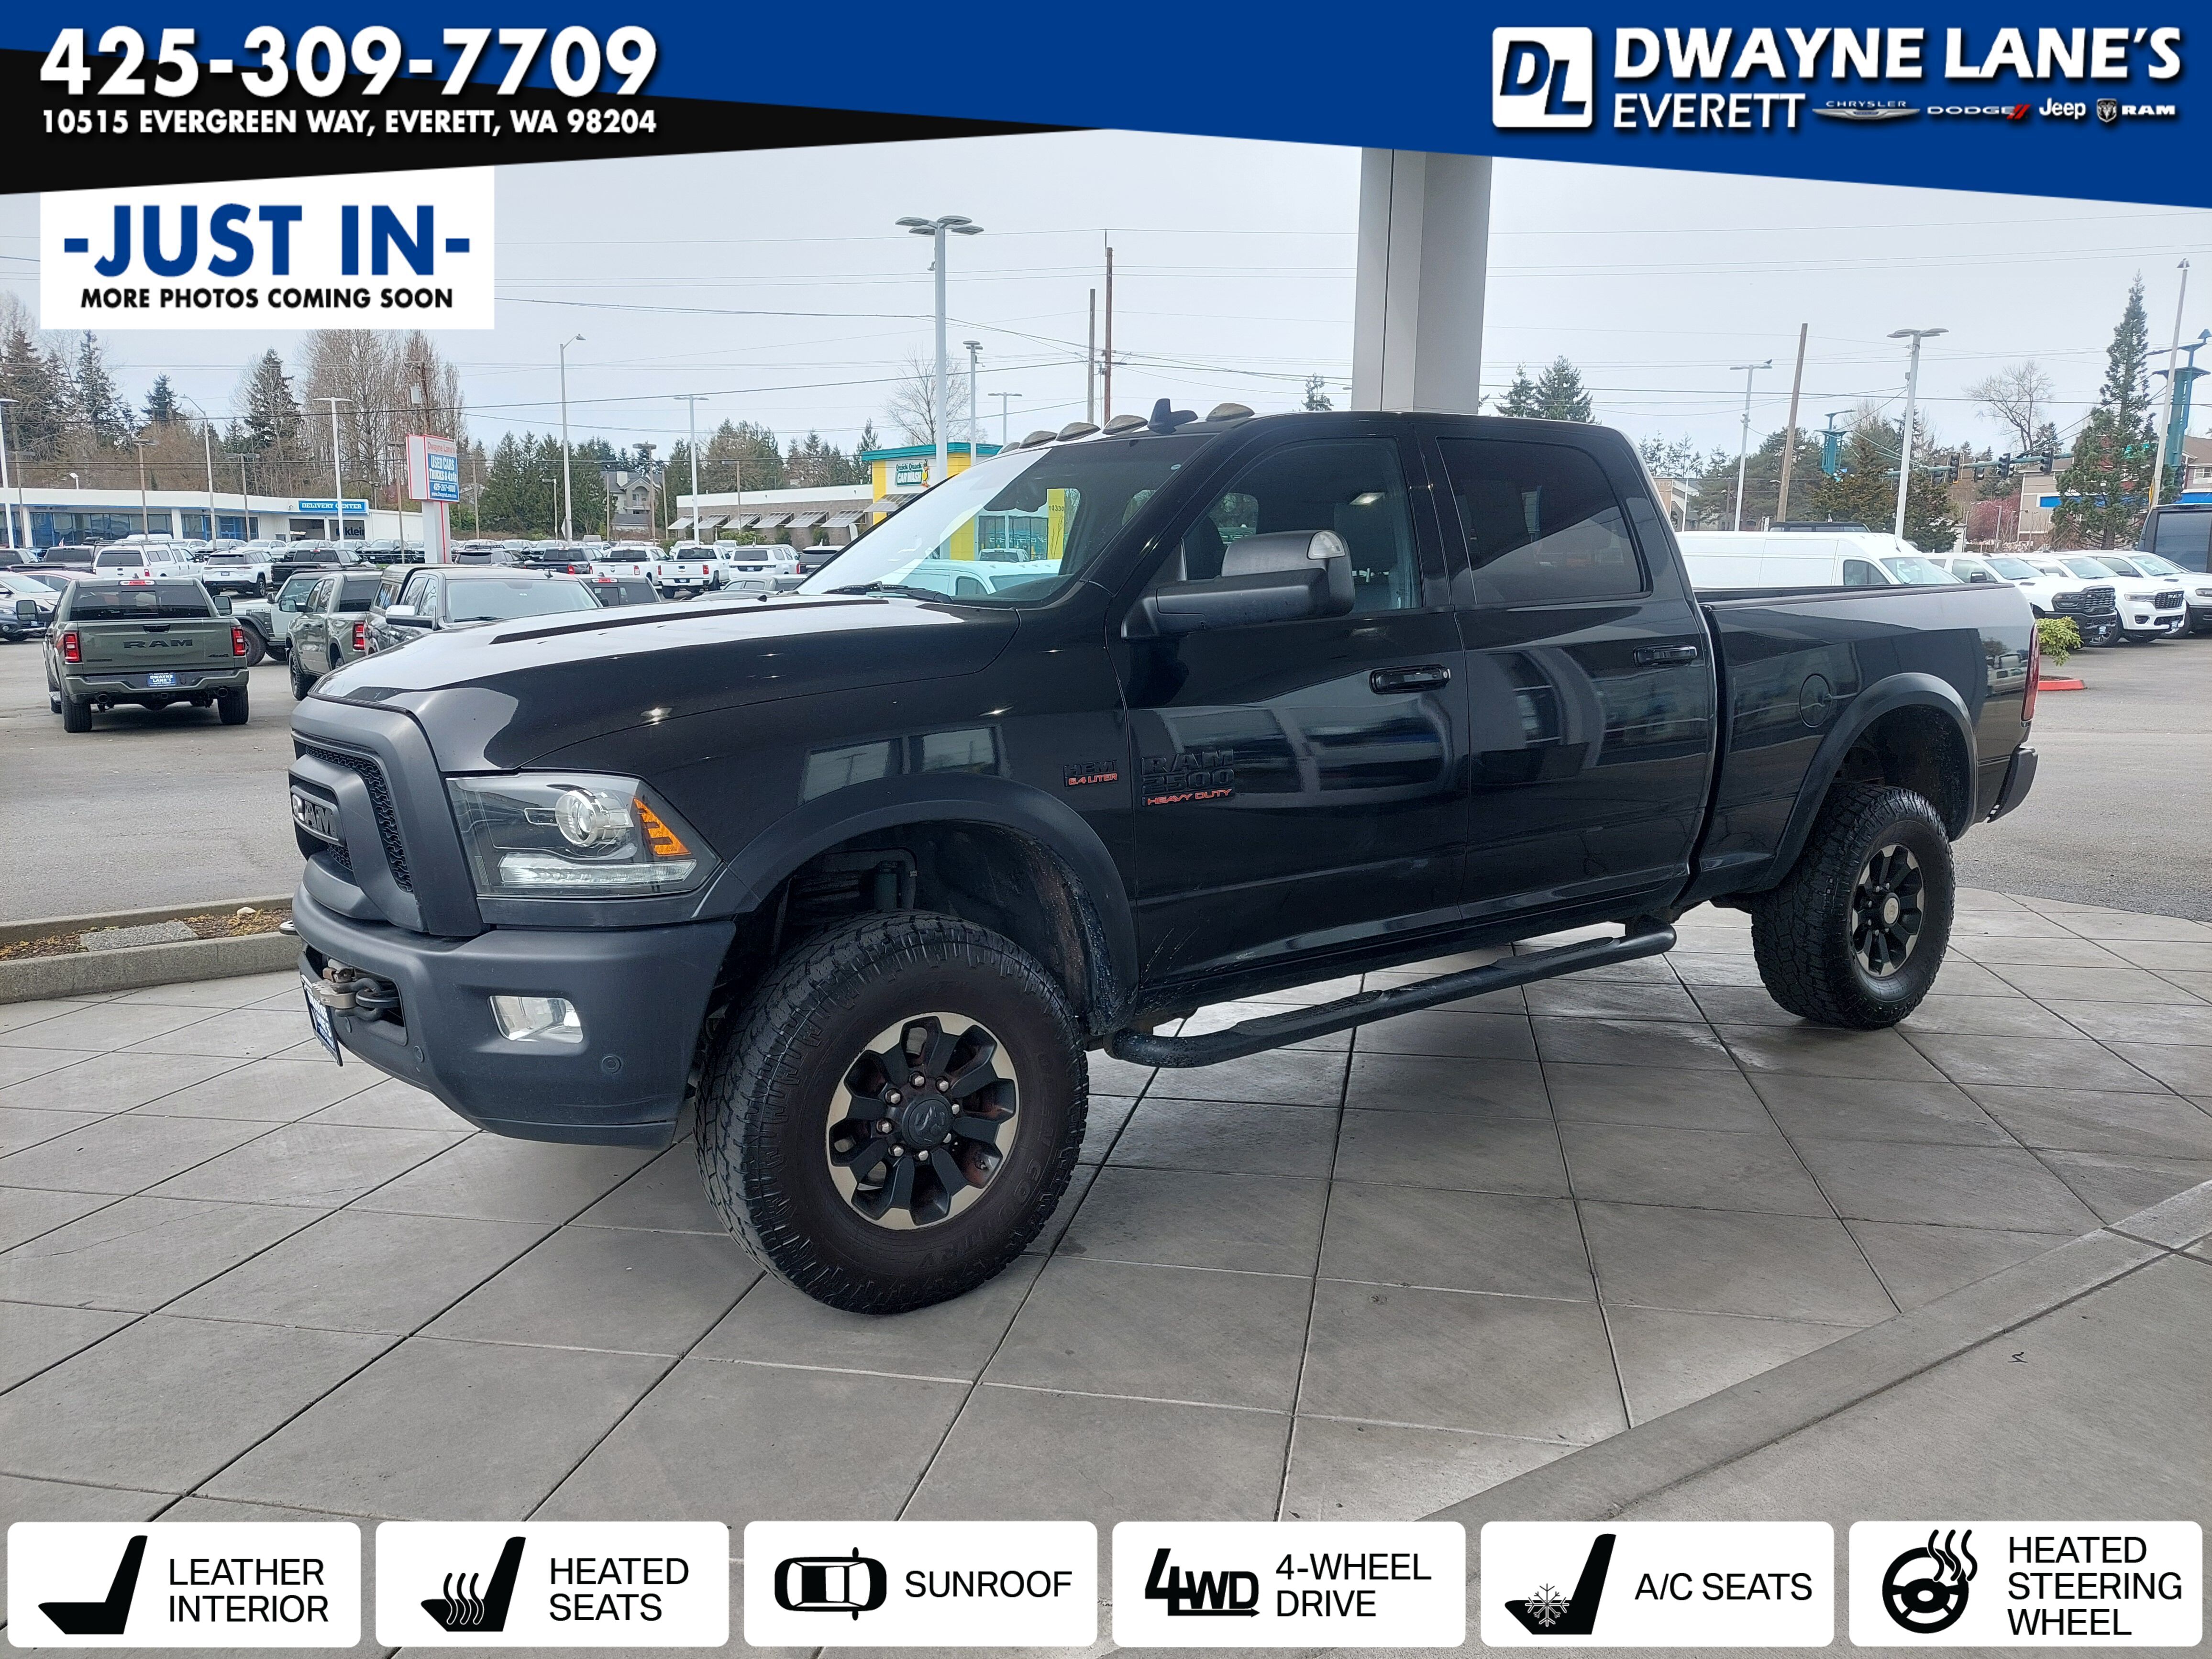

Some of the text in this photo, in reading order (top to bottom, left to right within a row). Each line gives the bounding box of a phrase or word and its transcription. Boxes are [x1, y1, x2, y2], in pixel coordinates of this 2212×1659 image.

[428, 441, 443, 452] Dwayne
[431, 455, 454, 471] USED CARS
[896, 462, 922, 471] Quick Quack
[897, 471, 922, 483] CAR WASH
[123, 639, 193, 649] RAM
[1141, 749, 1234, 774] RAM
[1068, 773, 1118, 785] 6.4 LITER
[1147, 788, 1232, 806] HEAVY DUTY
[292, 794, 338, 839] RAM
